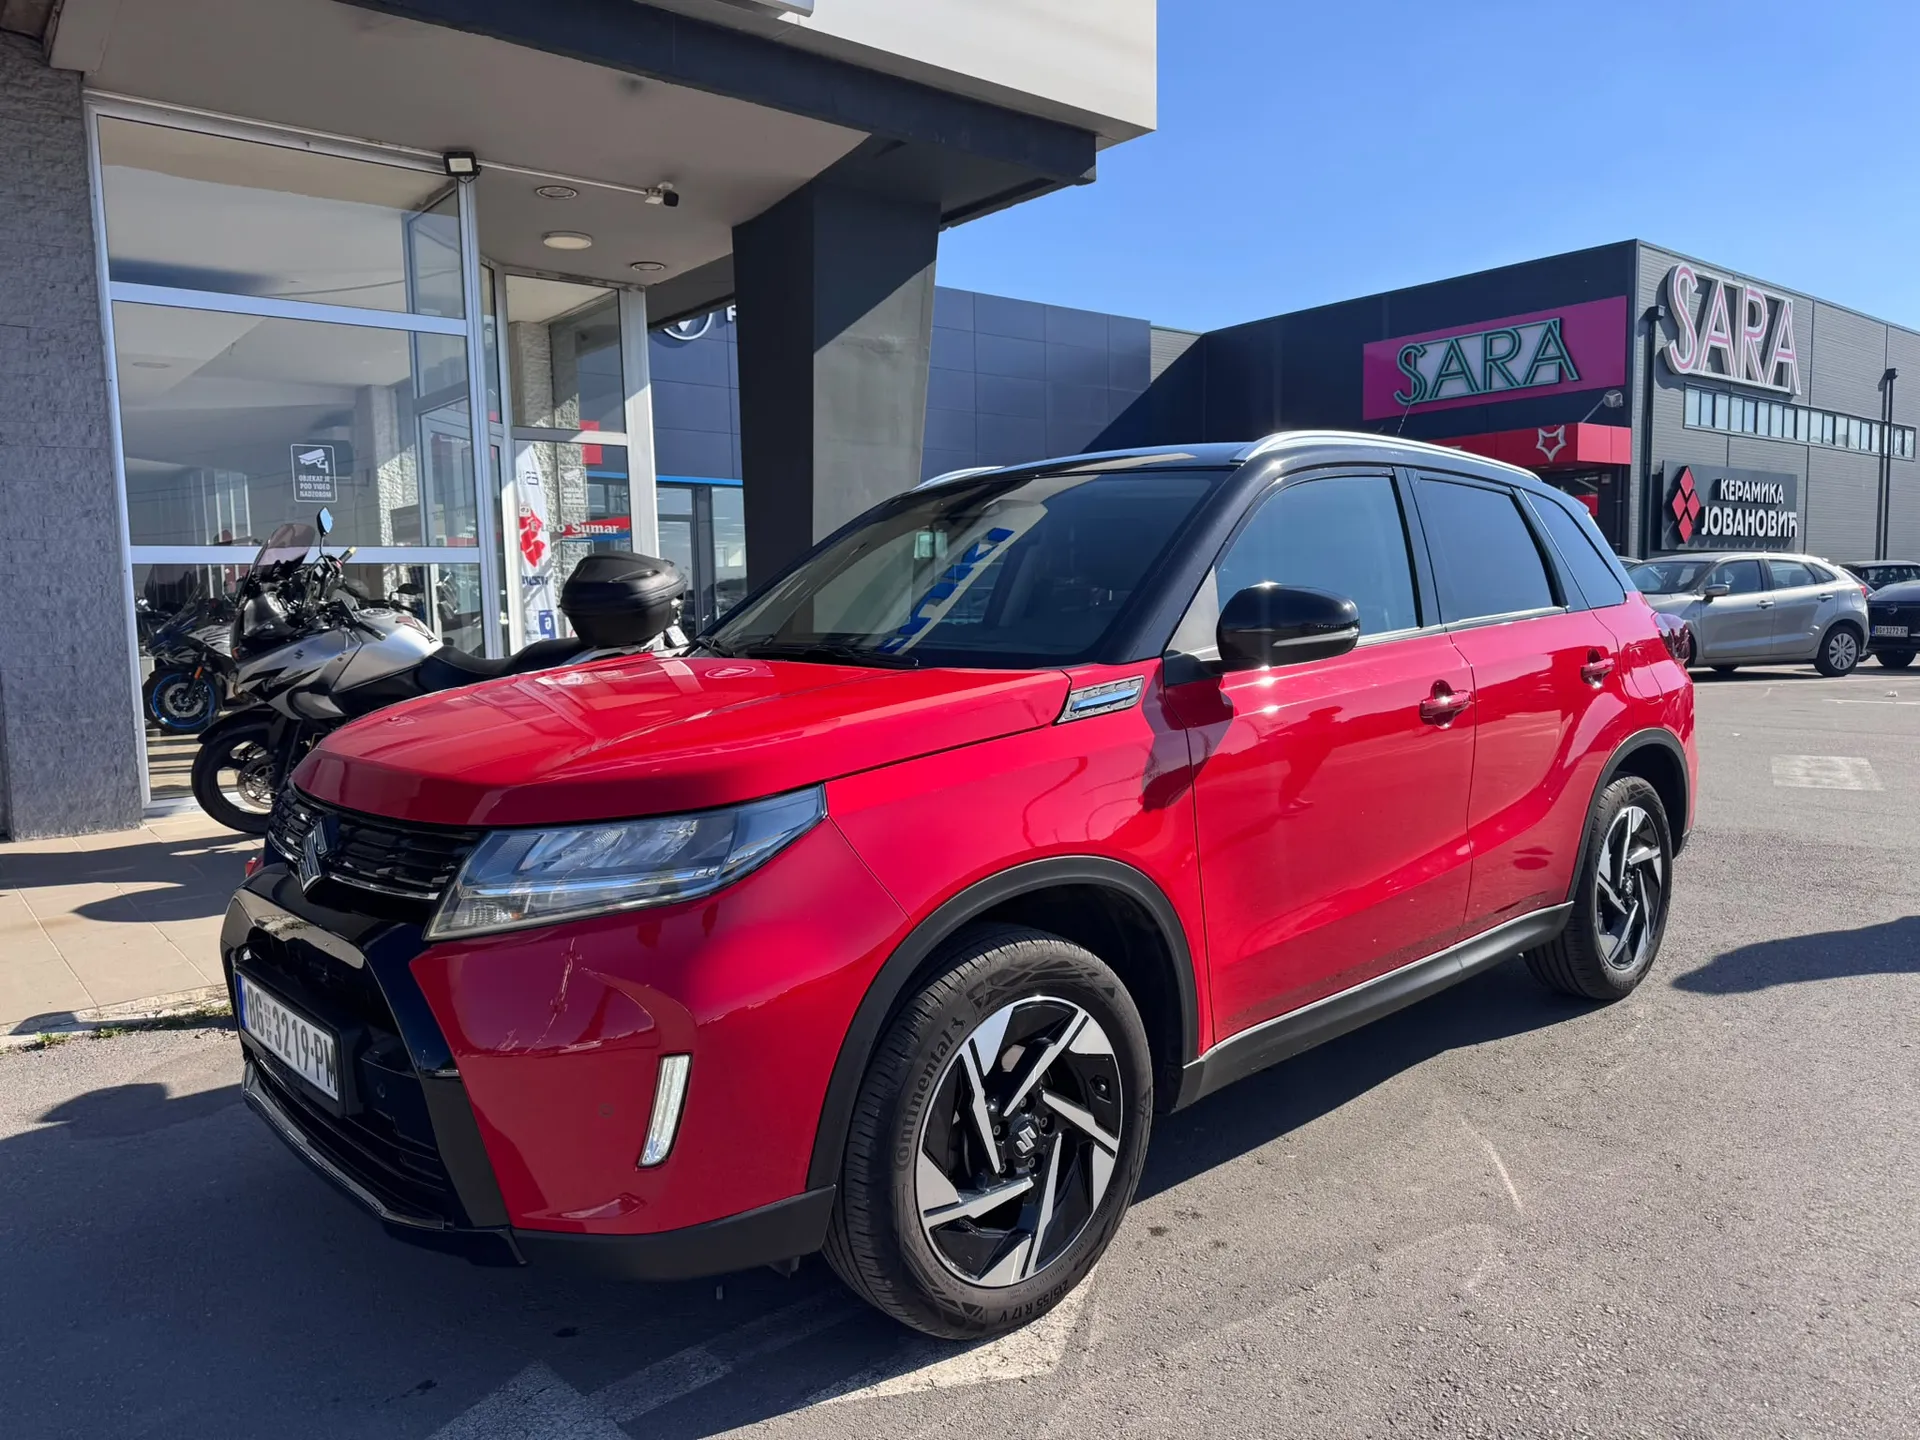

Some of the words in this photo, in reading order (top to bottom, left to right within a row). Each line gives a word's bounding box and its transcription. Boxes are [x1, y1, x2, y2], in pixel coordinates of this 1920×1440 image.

[1665, 262, 1801, 395] SARA
[1394, 317, 1581, 405] SARA
[1720, 479, 1784, 504] КЕРАМИКА
[571, 522, 620, 534] Sumar
[1701, 506, 1798, 537] ЈОВАНОВИЋ
[247, 984, 265, 1037] BG
